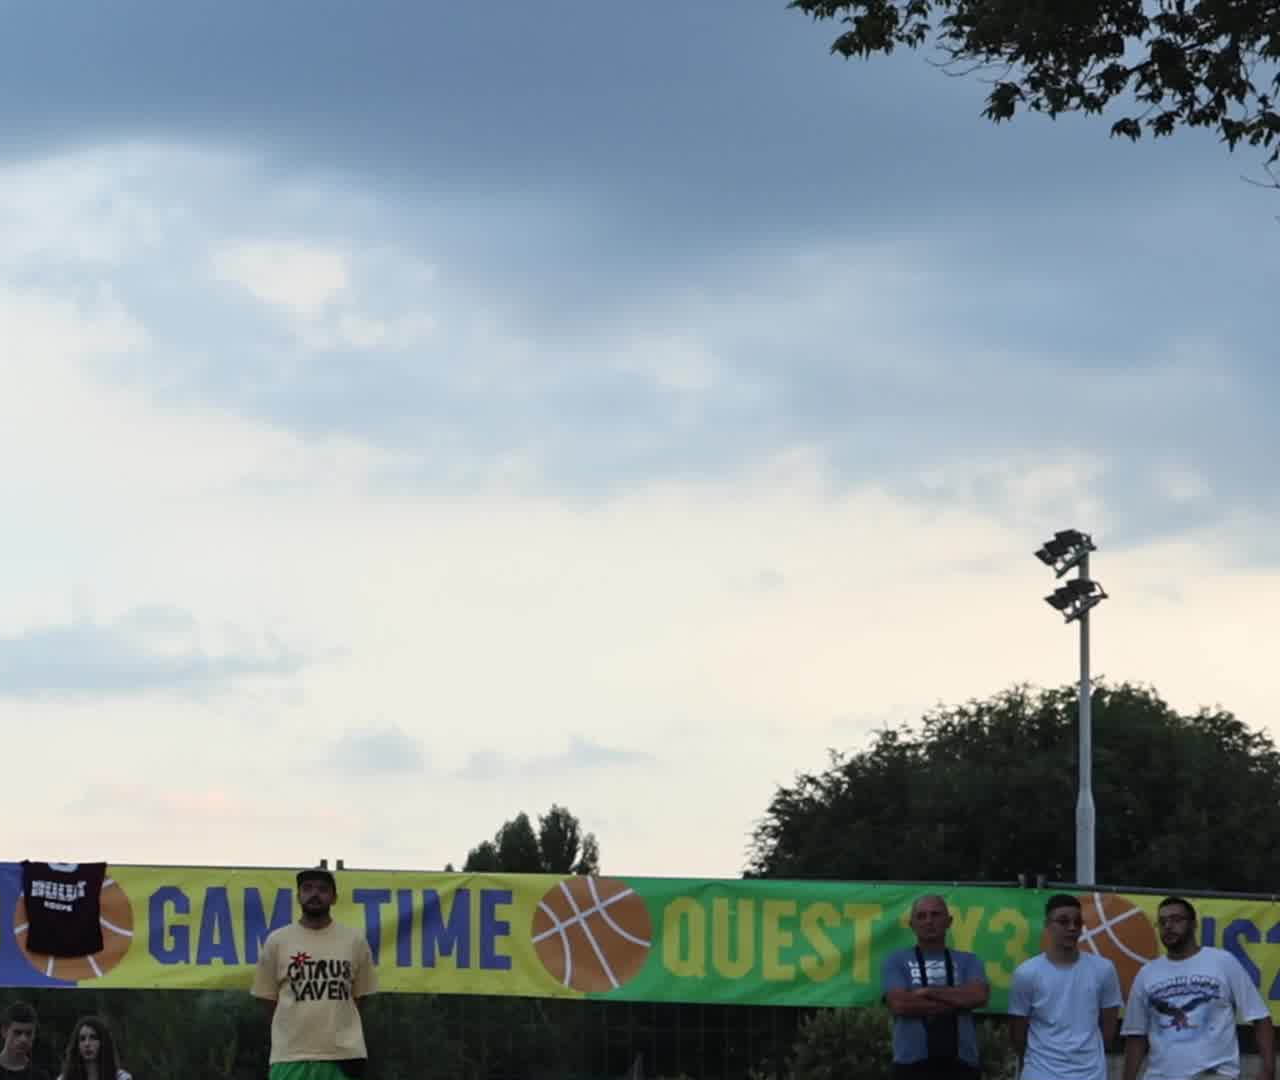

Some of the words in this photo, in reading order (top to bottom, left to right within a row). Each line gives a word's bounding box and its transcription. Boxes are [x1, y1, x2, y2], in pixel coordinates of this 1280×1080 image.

[148, 885, 294, 965] GAM
[353, 888, 513, 970] TIME
[287, 959, 351, 980] CITRUS
[663, 895, 886, 984] QUEST
